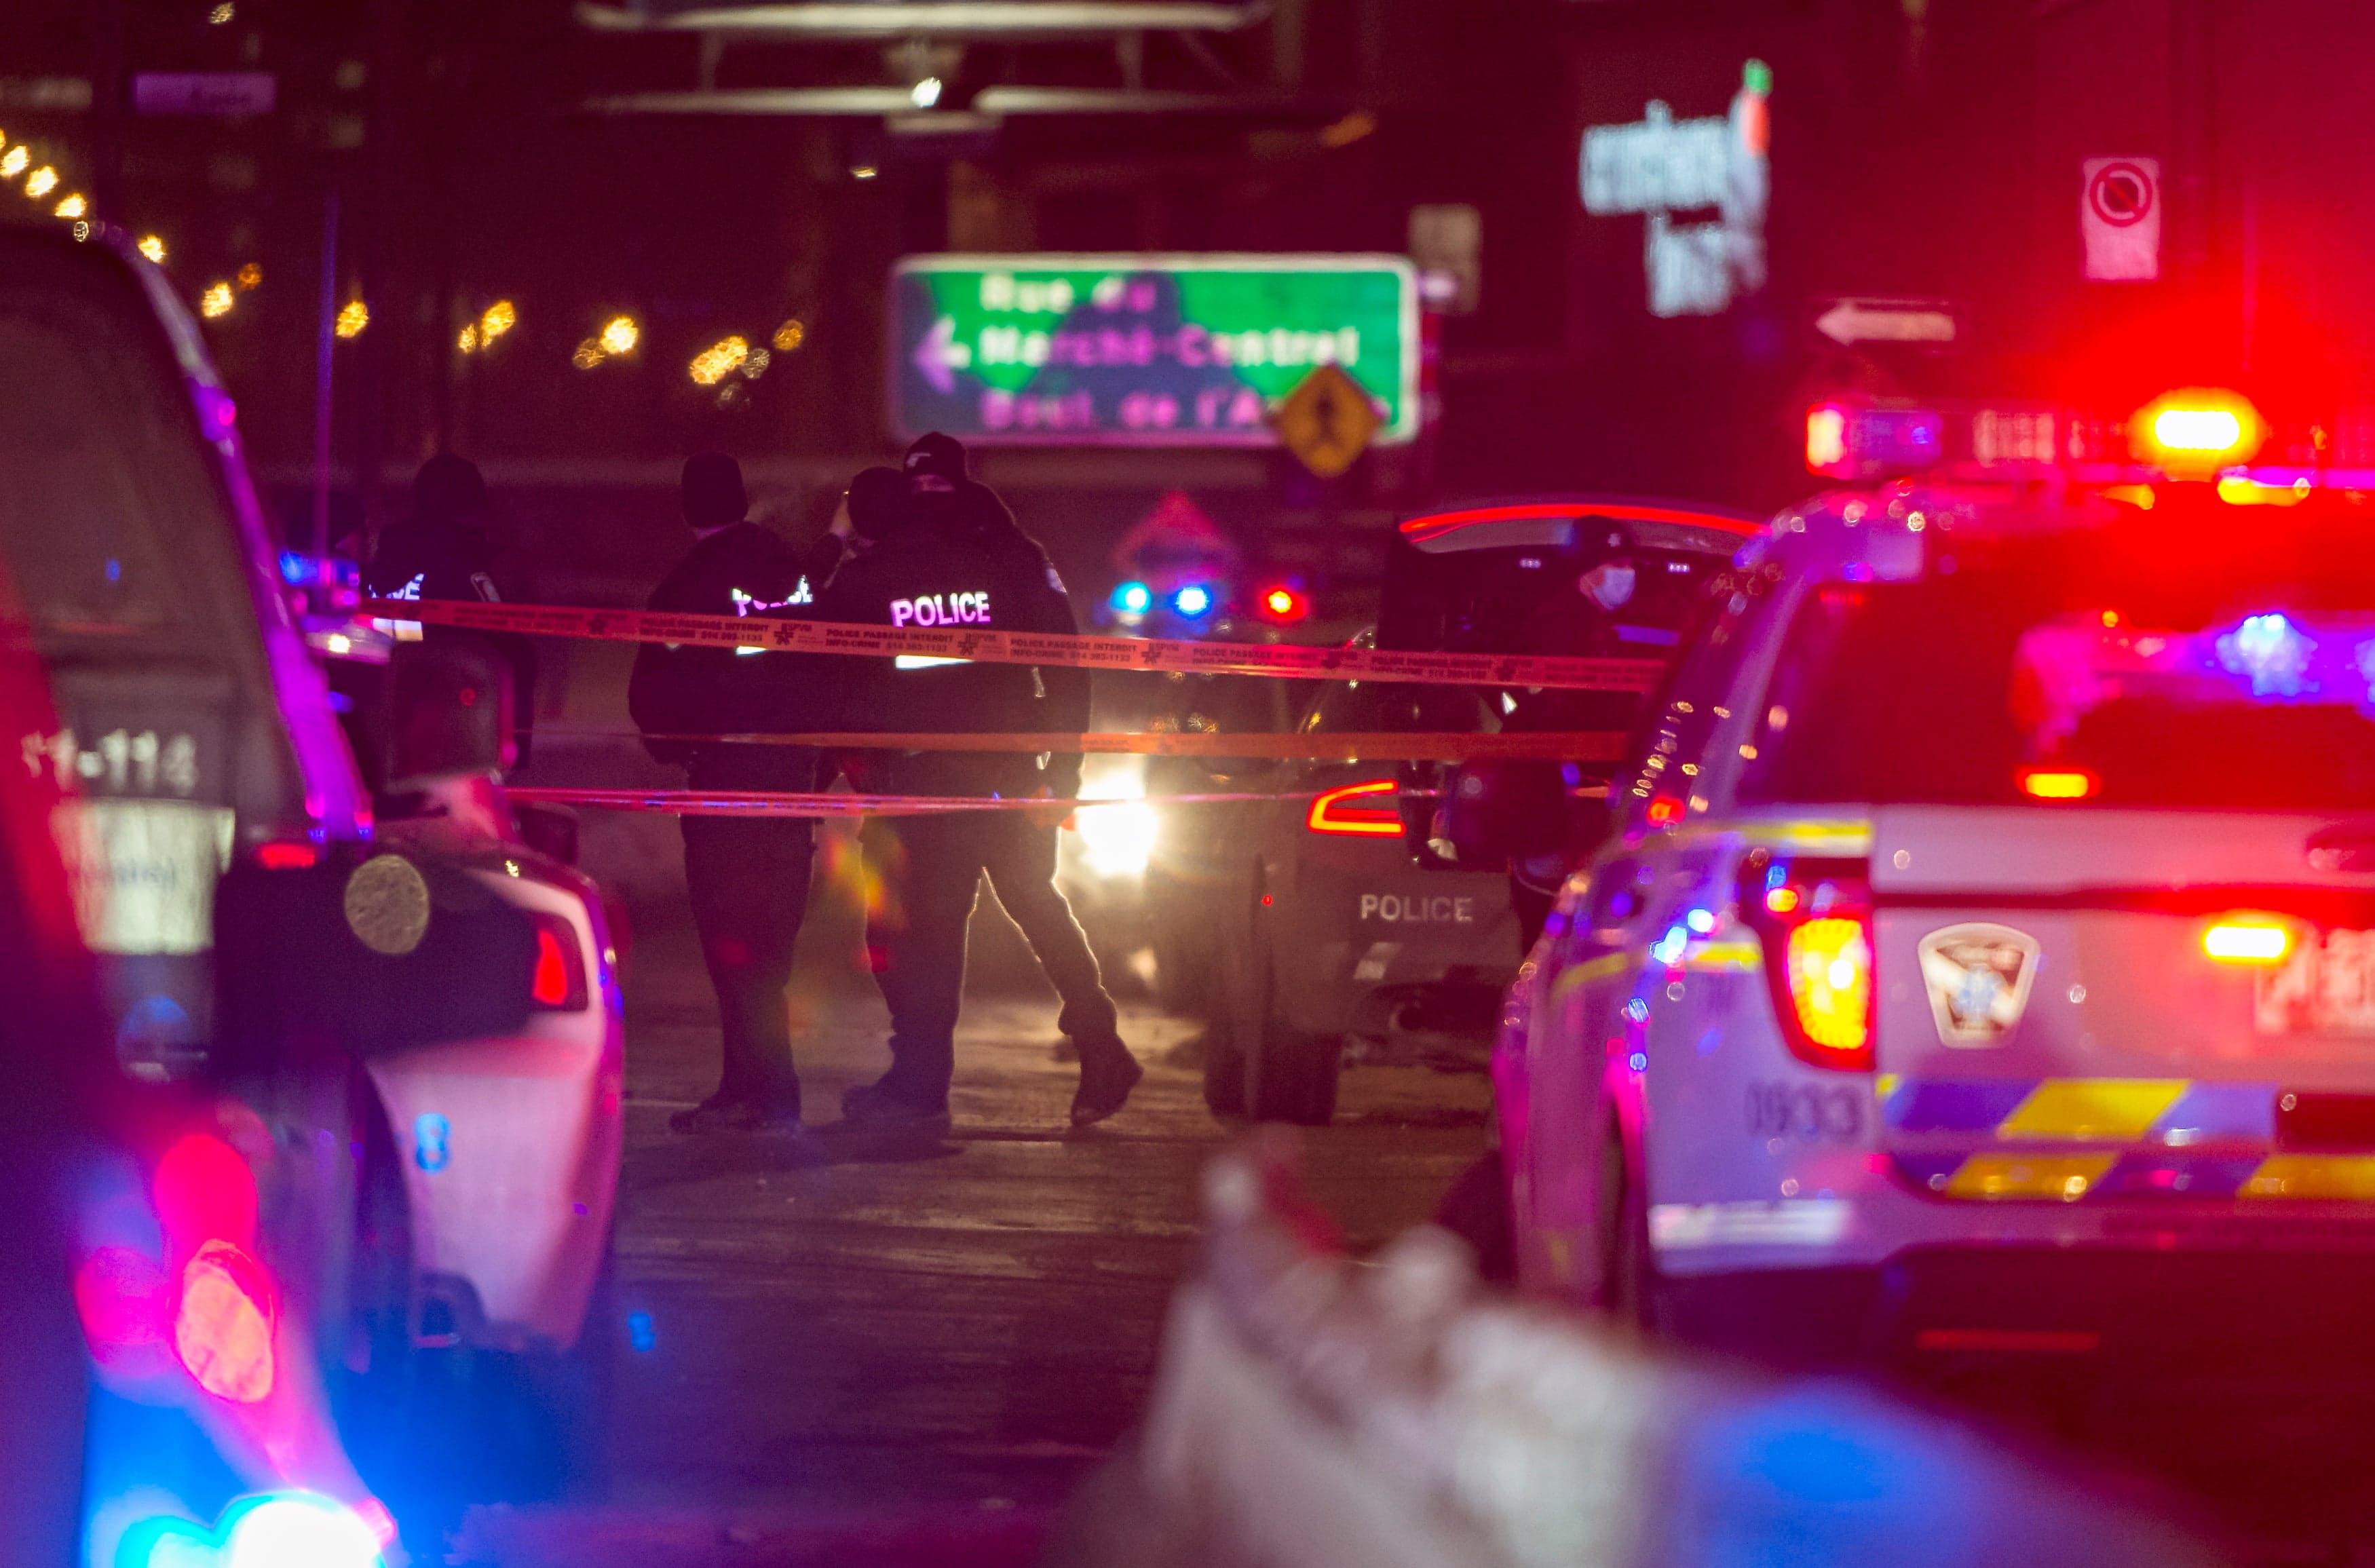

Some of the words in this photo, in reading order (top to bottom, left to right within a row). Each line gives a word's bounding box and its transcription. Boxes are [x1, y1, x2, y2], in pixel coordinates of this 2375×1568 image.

[980, 272, 1074, 312] Rue
[890, 592, 991, 628] POLICE
[825, 638, 881, 649] INFO-CRIME
[826, 629, 860, 638] POLICE
[863, 631, 907, 640] PASSAGE
[910, 633, 953, 642] INTERDIT
[1010, 638, 1044, 648] POLICE
[1047, 640, 1090, 650] PASSAGE
[1093, 643, 1137, 653] INTERDIT
[1361, 894, 1474, 923] POLICE
